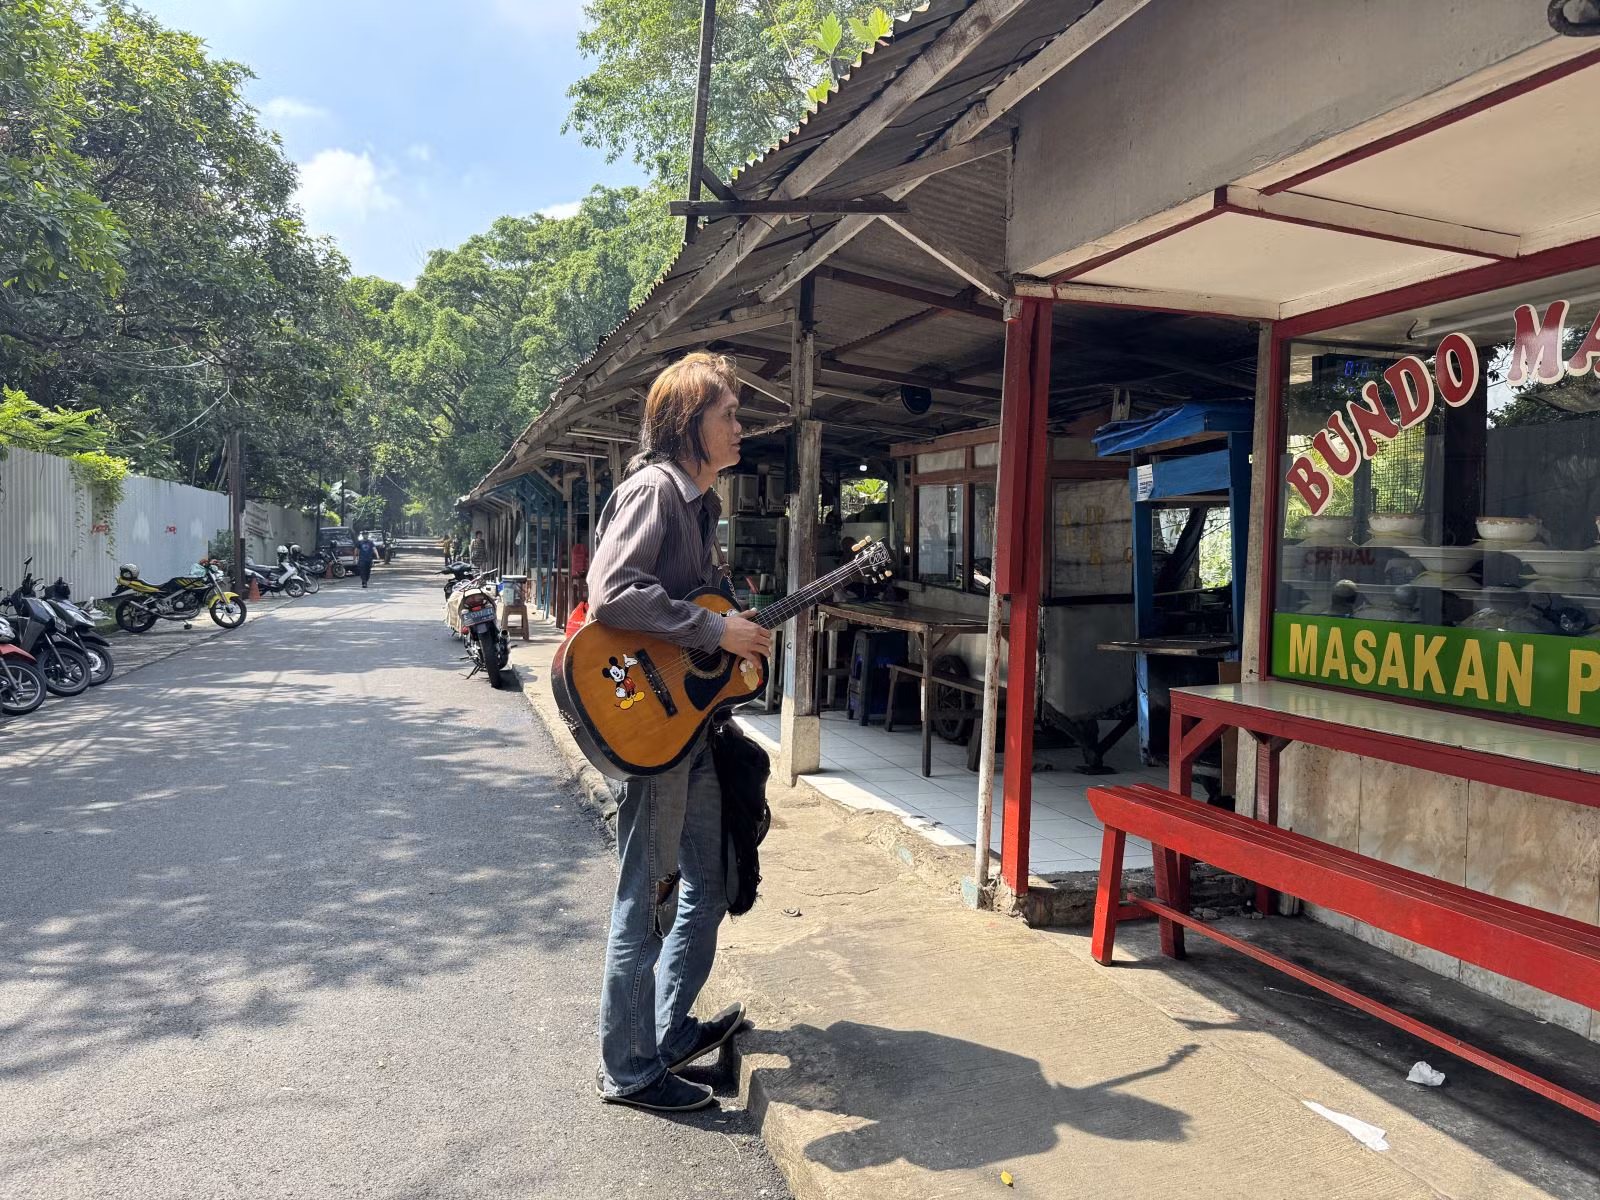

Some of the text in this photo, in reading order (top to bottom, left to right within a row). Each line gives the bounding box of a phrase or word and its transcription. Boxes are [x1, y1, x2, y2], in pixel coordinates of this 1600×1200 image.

[1286, 332, 1479, 516] BUNDO
[1289, 624, 1600, 715] MASAKAN P
